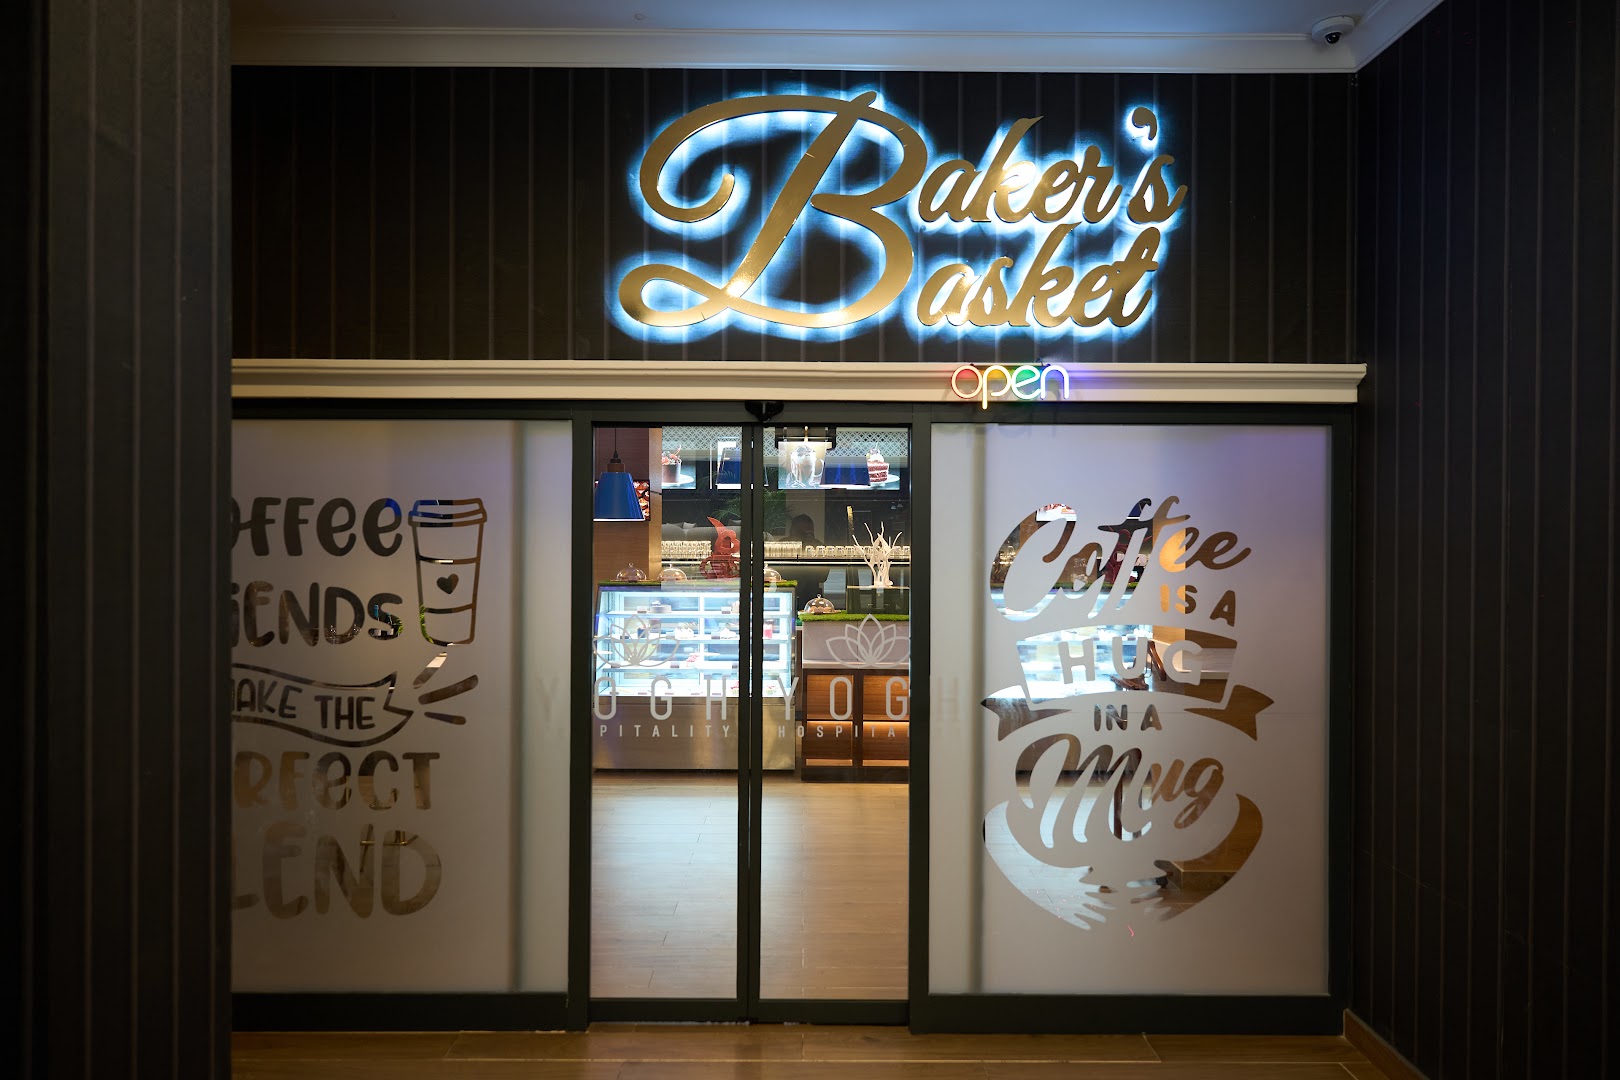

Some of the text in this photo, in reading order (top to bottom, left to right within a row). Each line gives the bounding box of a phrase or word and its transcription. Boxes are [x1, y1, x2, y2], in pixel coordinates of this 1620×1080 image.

[619, 91, 1188, 328] Baker's
[951, 364, 1069, 410] open
[989, 495, 1252, 622] Coffee
[1160, 583, 1236, 627] IS A
[1058, 636, 1202, 686] HUG
[231, 678, 376, 730] AKE THE
[1093, 703, 1163, 732] IN A
[1015, 733, 1224, 849] Mug
